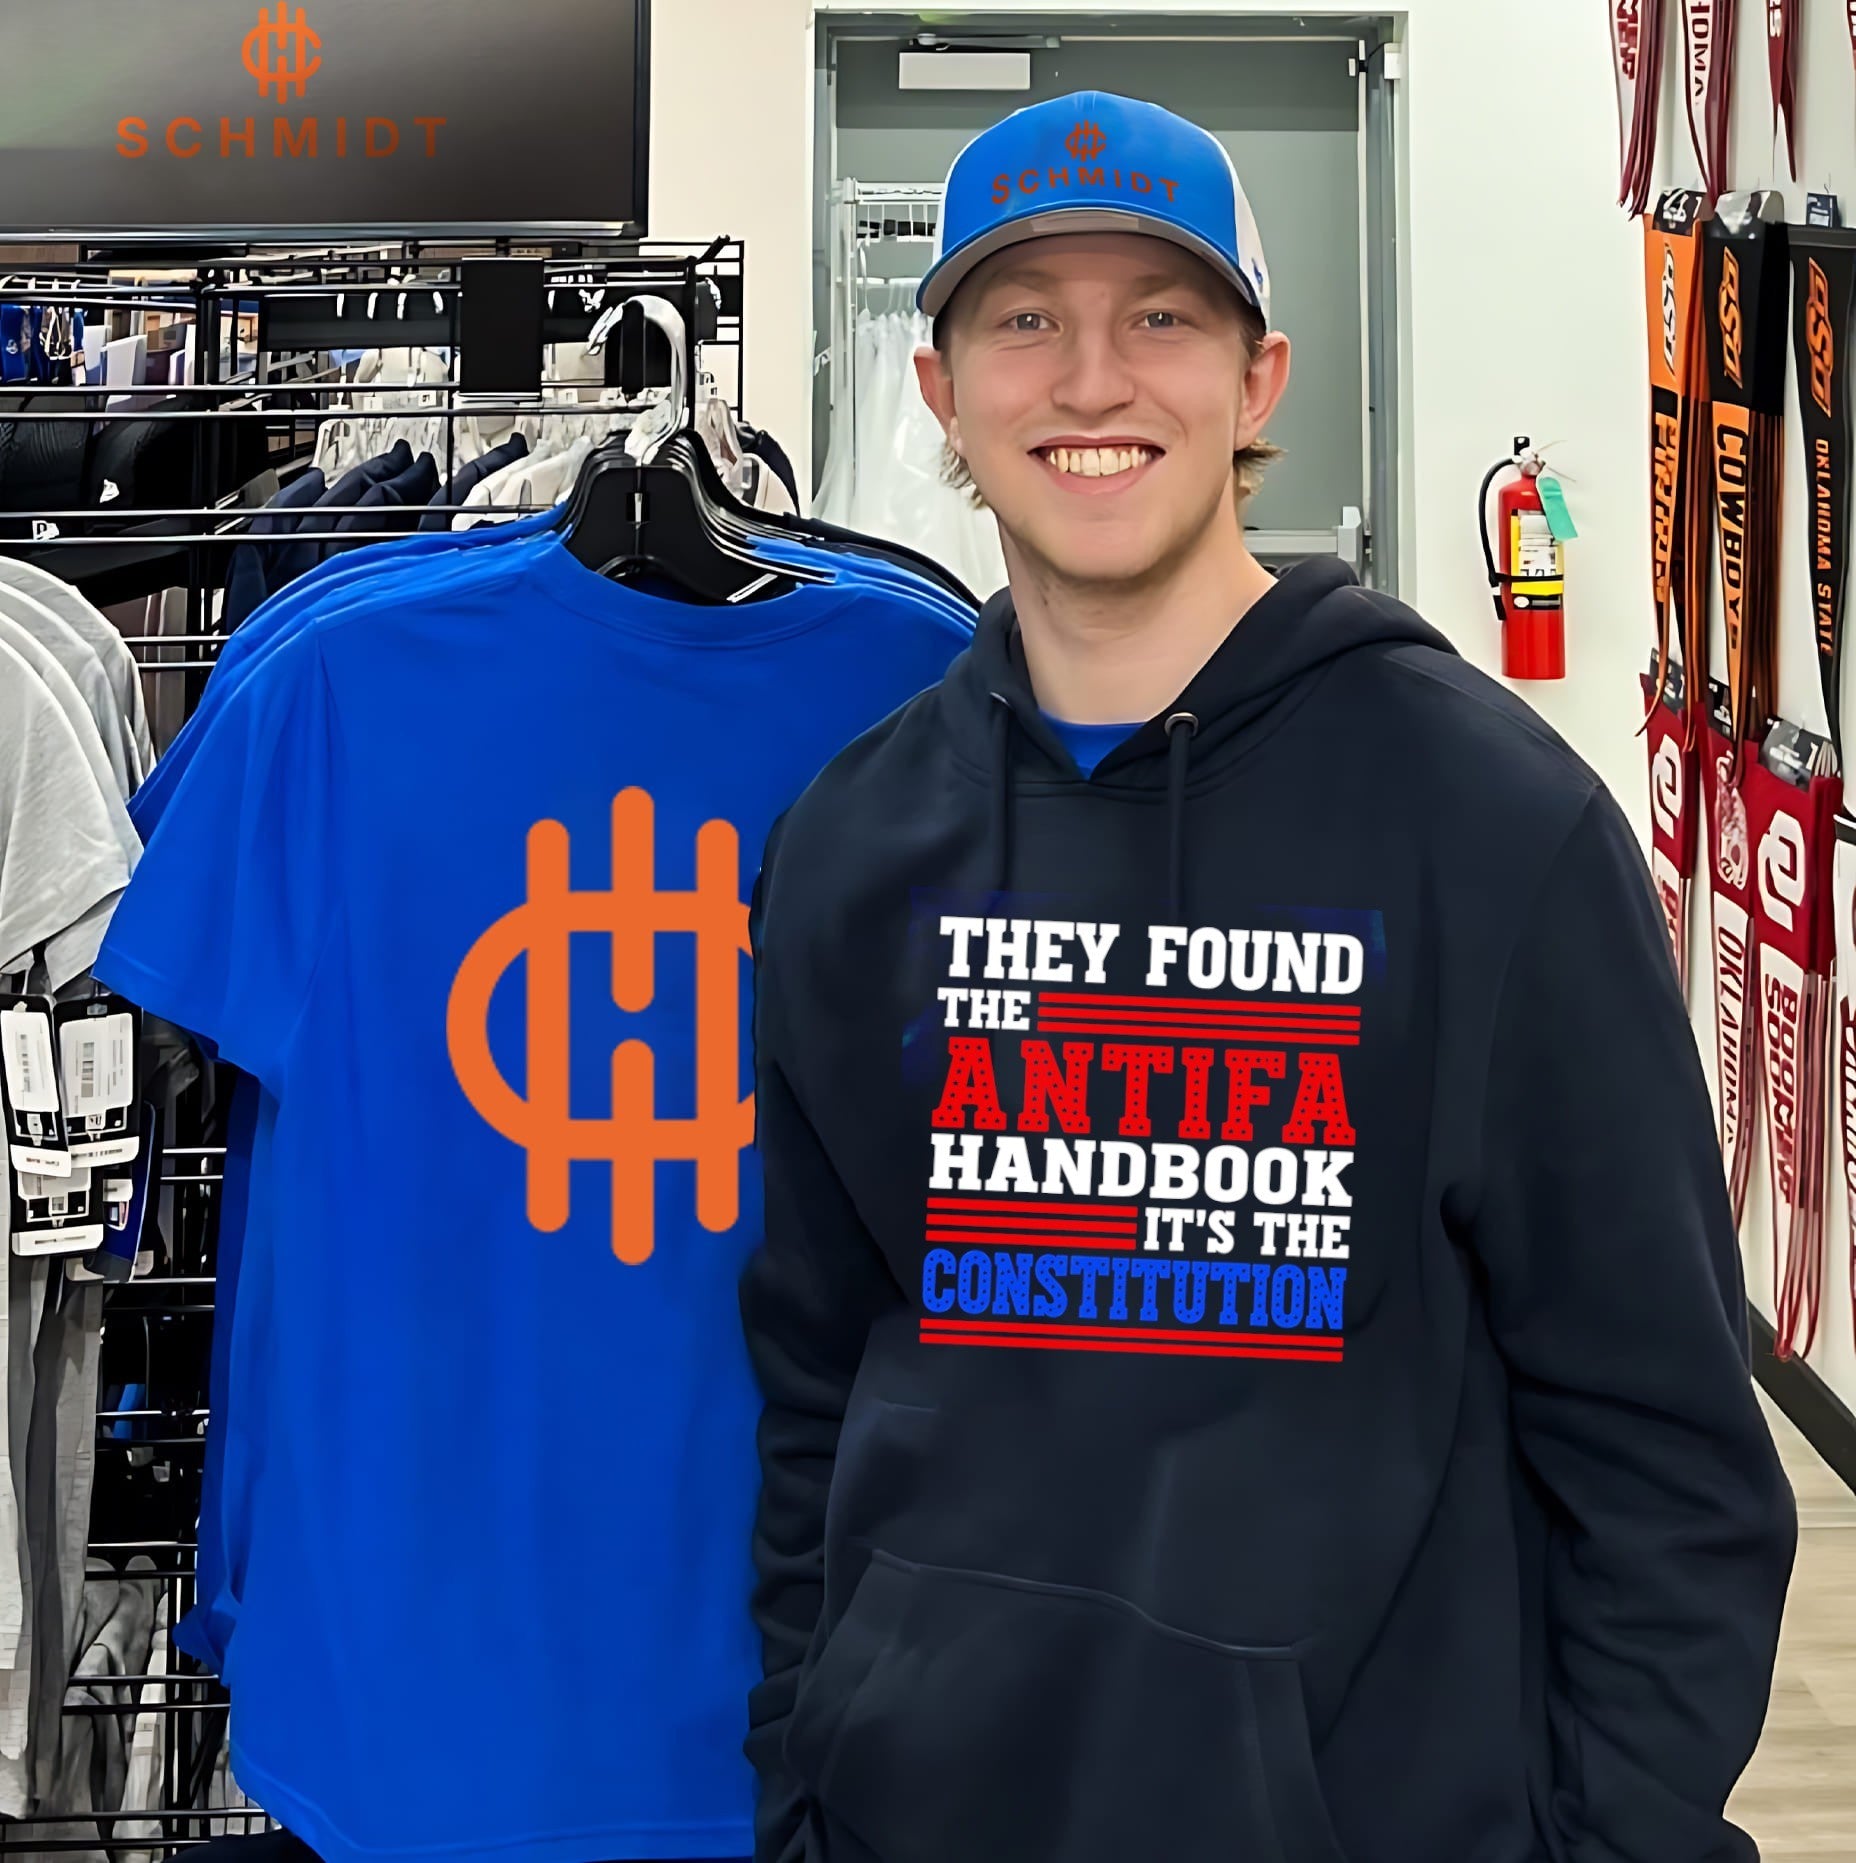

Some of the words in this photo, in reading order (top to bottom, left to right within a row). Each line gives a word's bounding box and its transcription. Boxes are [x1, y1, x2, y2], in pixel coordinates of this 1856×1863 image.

[115, 115, 448, 159] SCHMIDT
[992, 166, 1179, 205] SCHMIDT
[1815, 438, 1833, 571] OKLAHOMA
[1816, 583, 1835, 657] STATE
[939, 915, 1120, 984] THEY
[1145, 926, 1364, 995] FOUND
[937, 987, 1032, 1031] THE
[931, 1036, 1356, 1146] ANTIFA
[928, 1132, 1355, 1207] HANDBOOK
[1143, 1206, 1236, 1254] IT'S
[1253, 1211, 1351, 1259] THE
[922, 1248, 1347, 1330] CONSTITUTION
